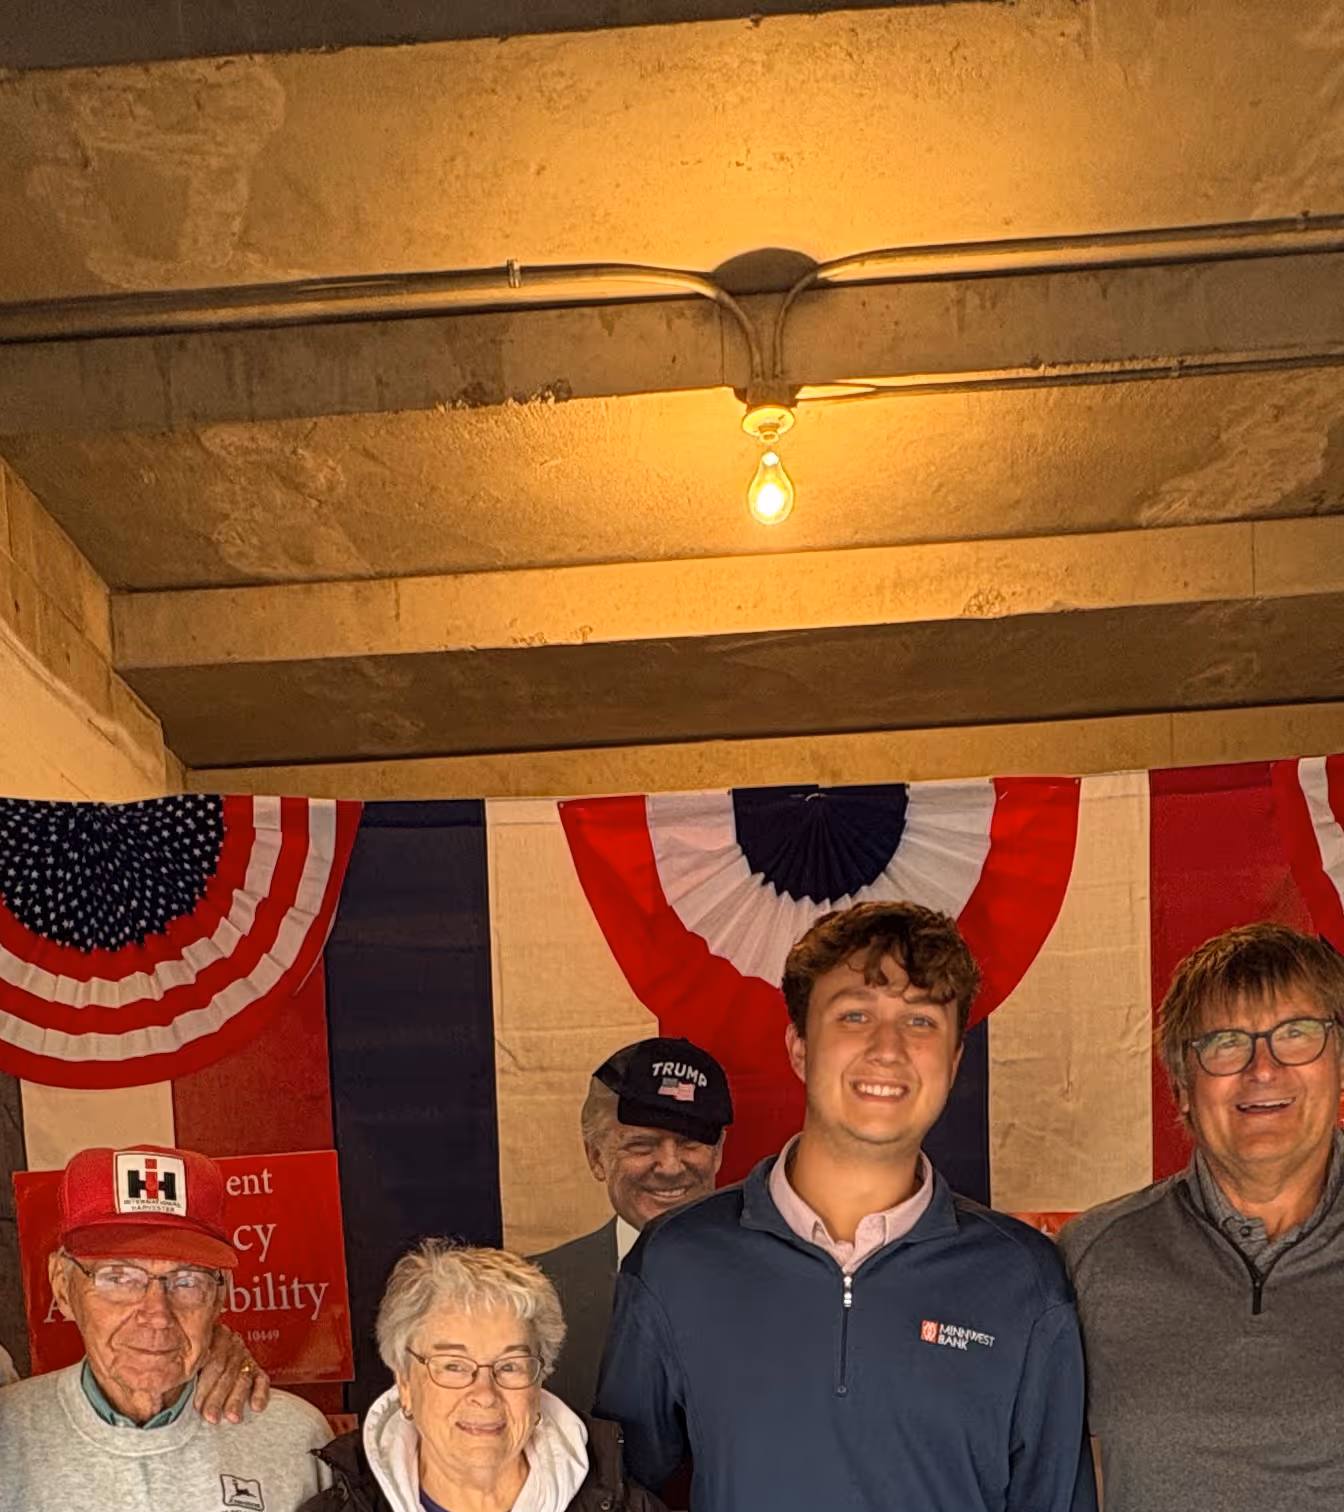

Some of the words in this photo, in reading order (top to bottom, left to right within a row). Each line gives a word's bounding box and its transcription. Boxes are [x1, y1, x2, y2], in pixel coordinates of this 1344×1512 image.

[652, 1062, 707, 1087] TRUMP
[220, 1272, 329, 1321] bility
[937, 1335, 968, 1351] BANK
[939, 1323, 996, 1347] MINNWEST
